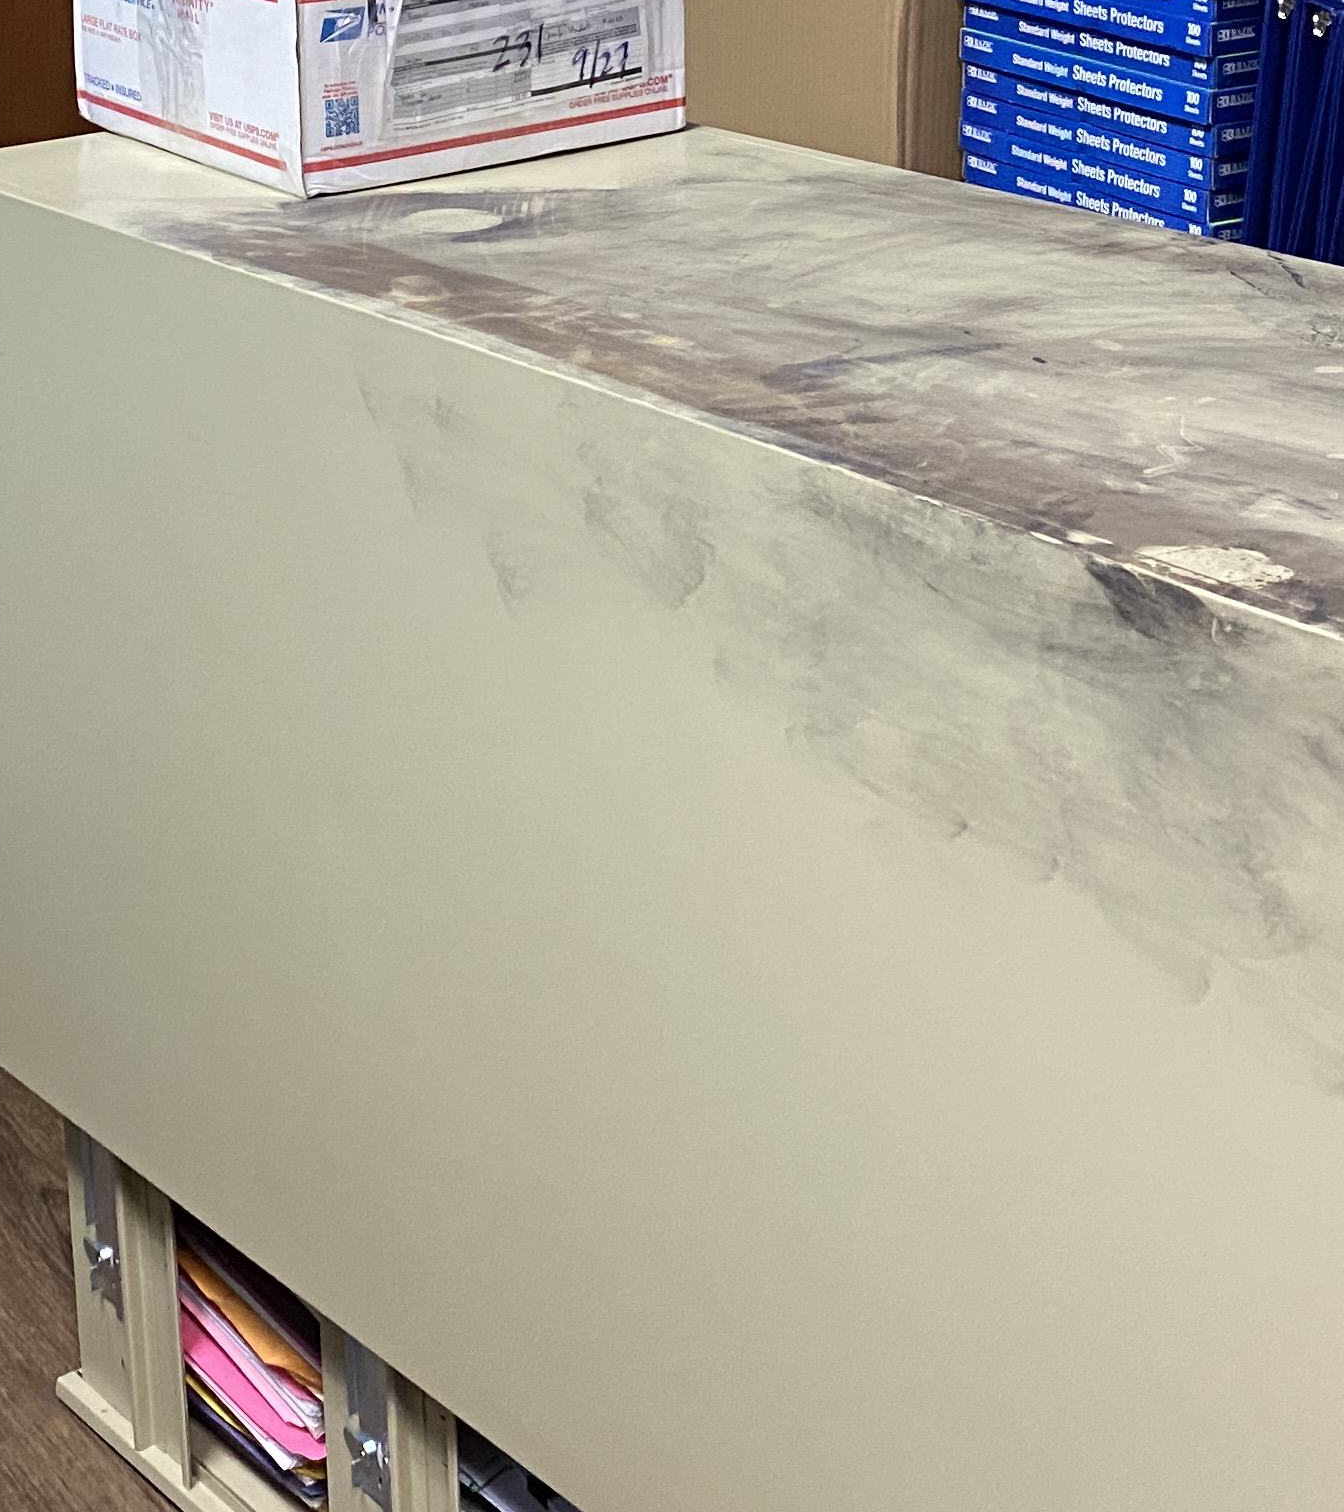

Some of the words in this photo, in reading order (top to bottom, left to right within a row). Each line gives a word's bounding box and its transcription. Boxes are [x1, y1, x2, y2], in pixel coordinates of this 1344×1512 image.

[1110, 7, 1165, 34] Protectors
[1187, 22, 1202, 37] 100
[1018, 20, 1049, 38] Standard
[1050, 28, 1075, 44] Weight
[1079, 32, 1114, 54] Sheets
[1115, 40, 1171, 67] Protectors
[1012, 53, 1044, 71] Standard
[1044, 61, 1069, 78] Weight
[1072, 64, 1107, 87] Sheets
[1108, 74, 1163, 102] Protectors
[1016, 84, 1048, 102] Standard
[1048, 92, 1074, 109] Weight
[1077, 96, 1112, 119] Sheets
[1113, 107, 1168, 134] Protectors
[1186, 90, 1200, 106] 100
[1016, 114, 1048, 134] Standard
[1047, 122, 1072, 141] Weight
[1076, 128, 1111, 151] Sheets
[1112, 138, 1166, 167] Protectors
[1011, 144, 1043, 163] Standard
[1043, 154, 1068, 171] Weight
[1071, 158, 1106, 182] Sheets
[1107, 168, 1161, 199] Protectors
[1189, 156, 1203, 171] 100
[1016, 176, 1048, 195] Standard
[1047, 185, 1072, 203] Weight
[1075, 191, 1110, 214] Sheets
[1183, 188, 1198, 204] 100
